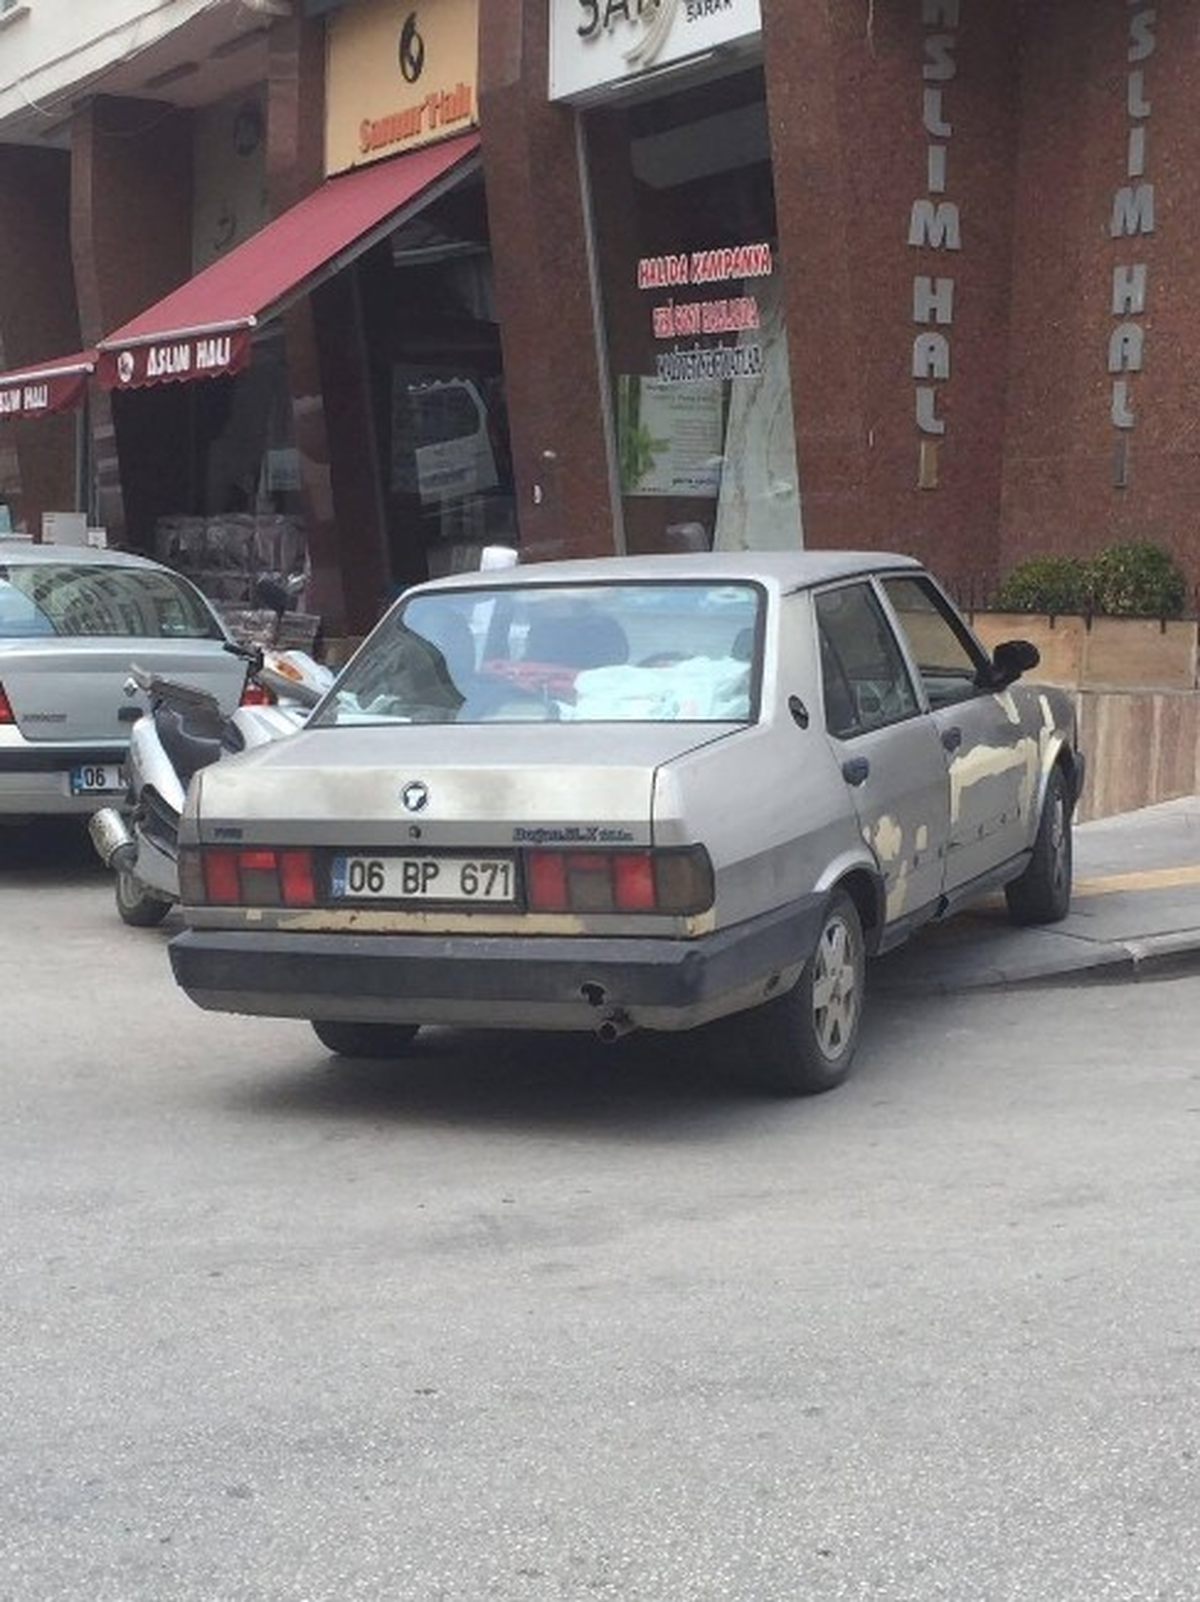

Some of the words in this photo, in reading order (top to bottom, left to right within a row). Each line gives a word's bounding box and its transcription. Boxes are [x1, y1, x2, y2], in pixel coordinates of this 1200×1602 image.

[1110, 0, 1156, 238] SLIM
[83, 767, 106, 788] 06
[350, 859, 385, 893] 06
[402, 861, 440, 894] BP
[460, 862, 511, 897] 671
